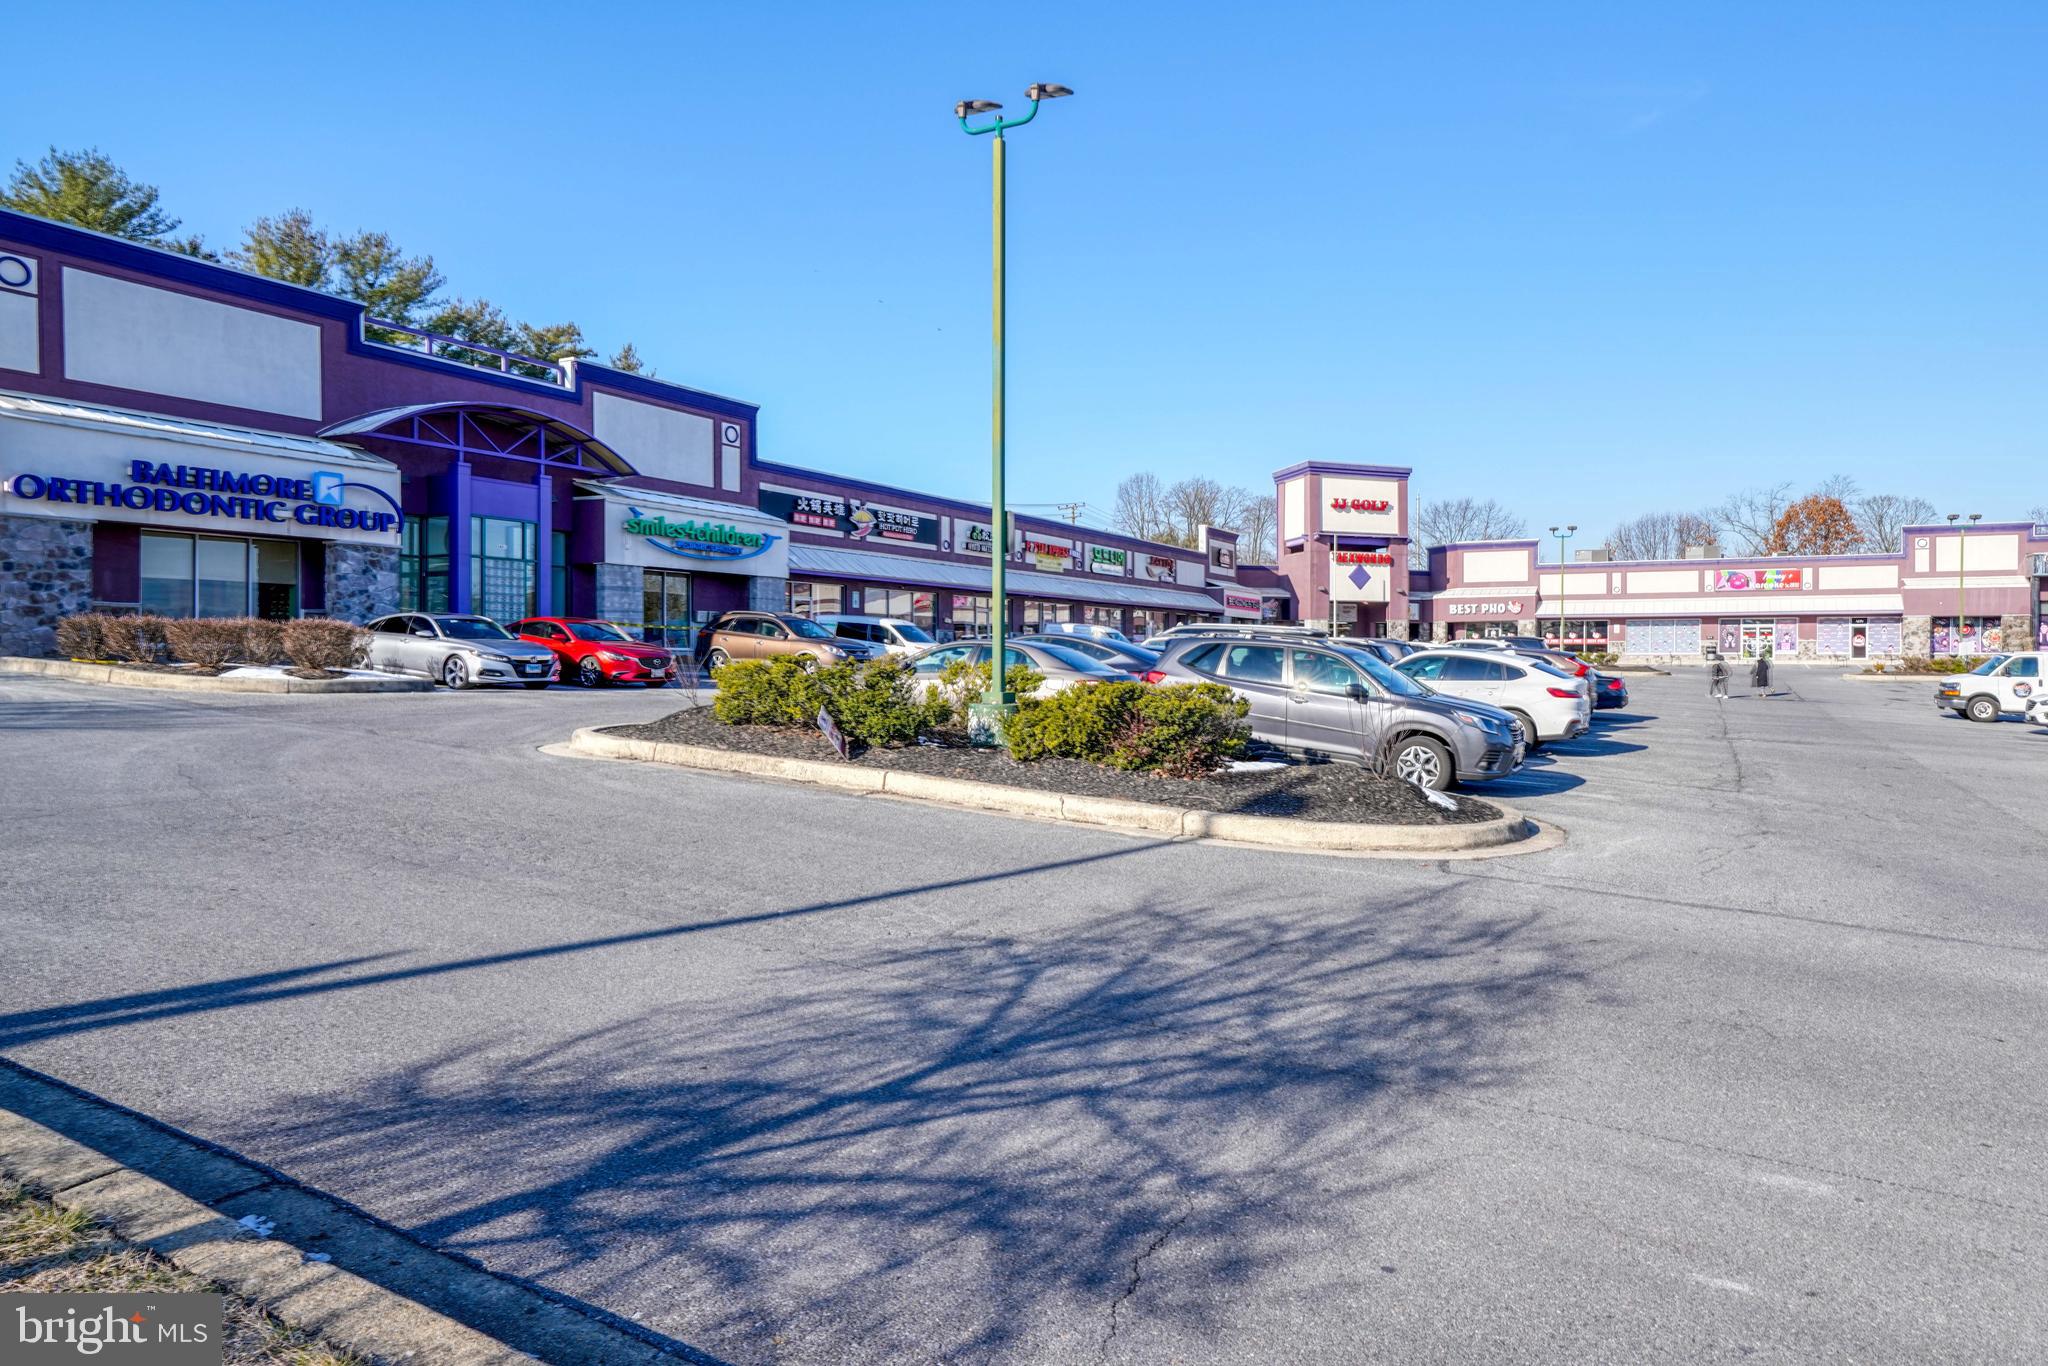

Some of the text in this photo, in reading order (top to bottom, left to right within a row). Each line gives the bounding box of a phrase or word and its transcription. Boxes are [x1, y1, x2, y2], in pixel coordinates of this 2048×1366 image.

[131, 460, 311, 500] BALTIMORE
[13, 474, 395, 532] ORTHODONTIC GROUP
[1331, 498, 1389, 512] JJ GOLF
[626, 516, 762, 547] smiles4children
[1449, 603, 1506, 614] BEST PHO
